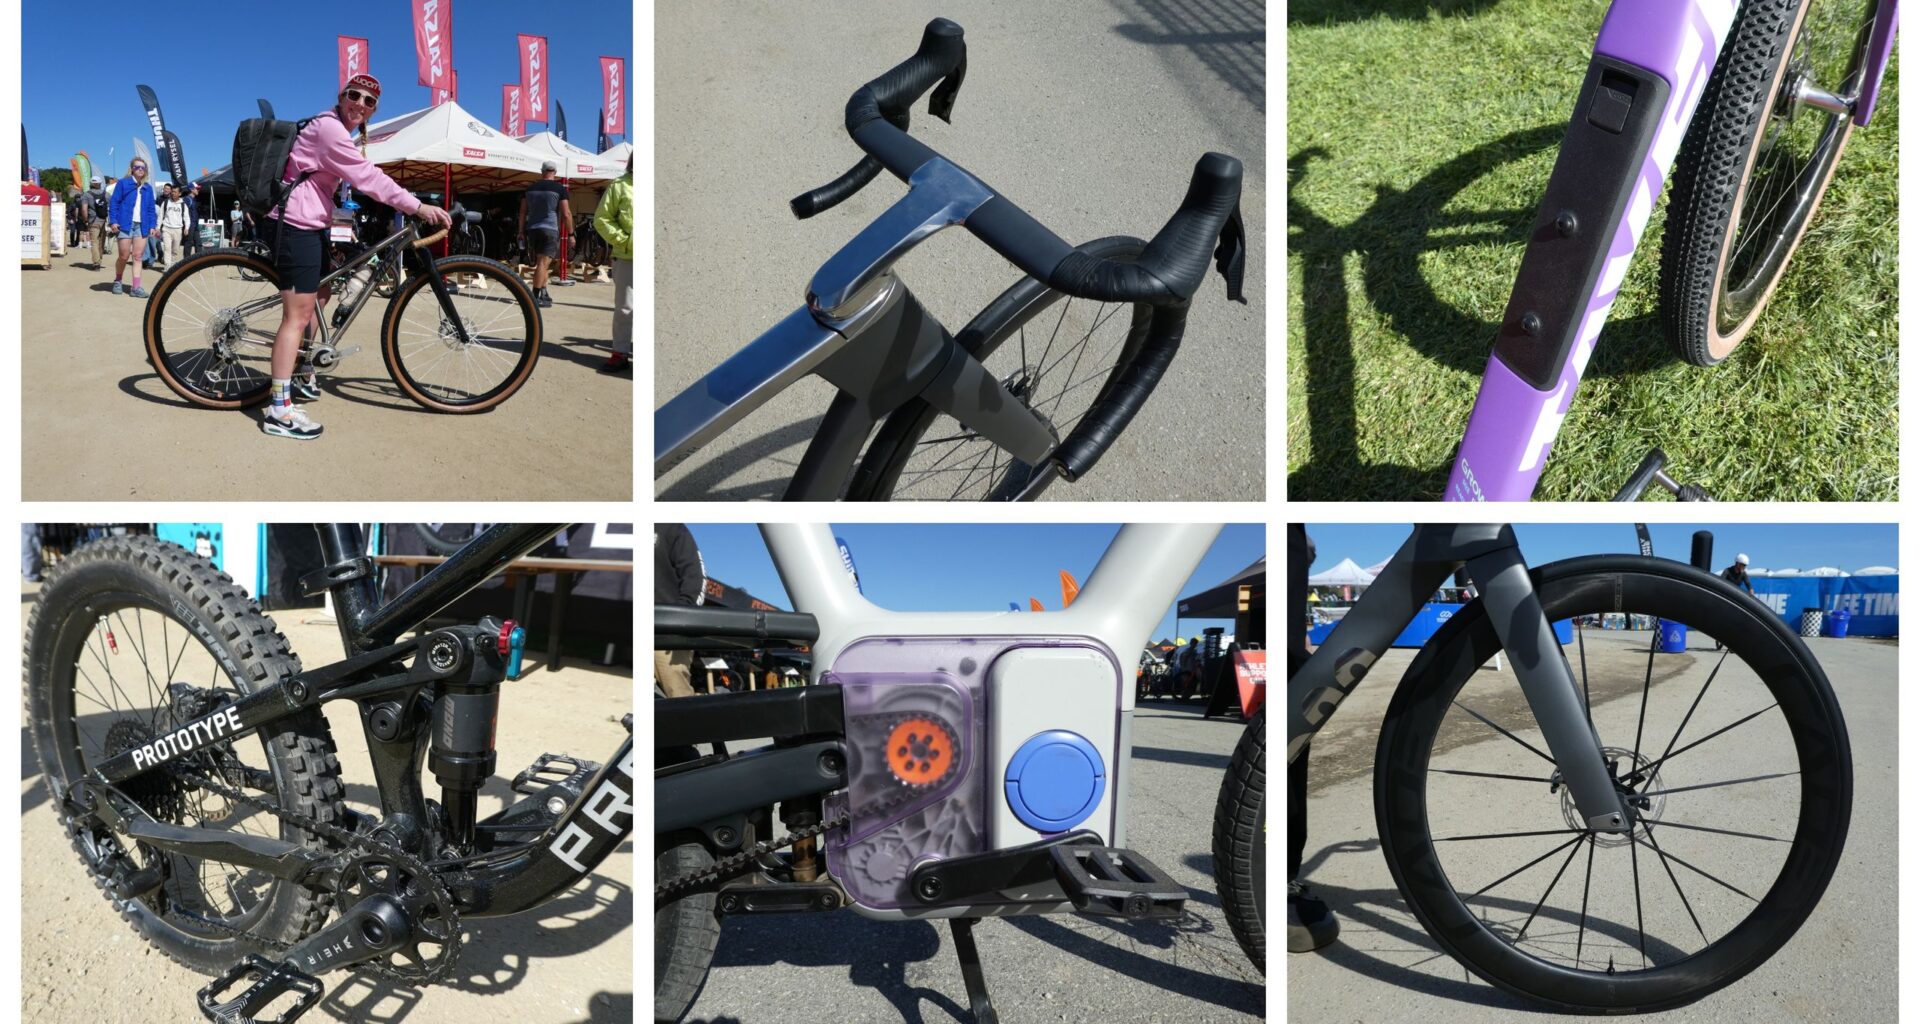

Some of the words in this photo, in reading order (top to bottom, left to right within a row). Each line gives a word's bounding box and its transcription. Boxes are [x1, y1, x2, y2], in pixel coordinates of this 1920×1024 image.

[147, 107, 165, 149] THULE
[168, 139, 179, 162] RYSEL
[173, 162, 182, 179] VAN
[1755, 593, 1788, 615] IME
[197, 620, 238, 673] TIRE
[131, 705, 243, 770] PROTOTYPE
[307, 943, 343, 965] HEIR
